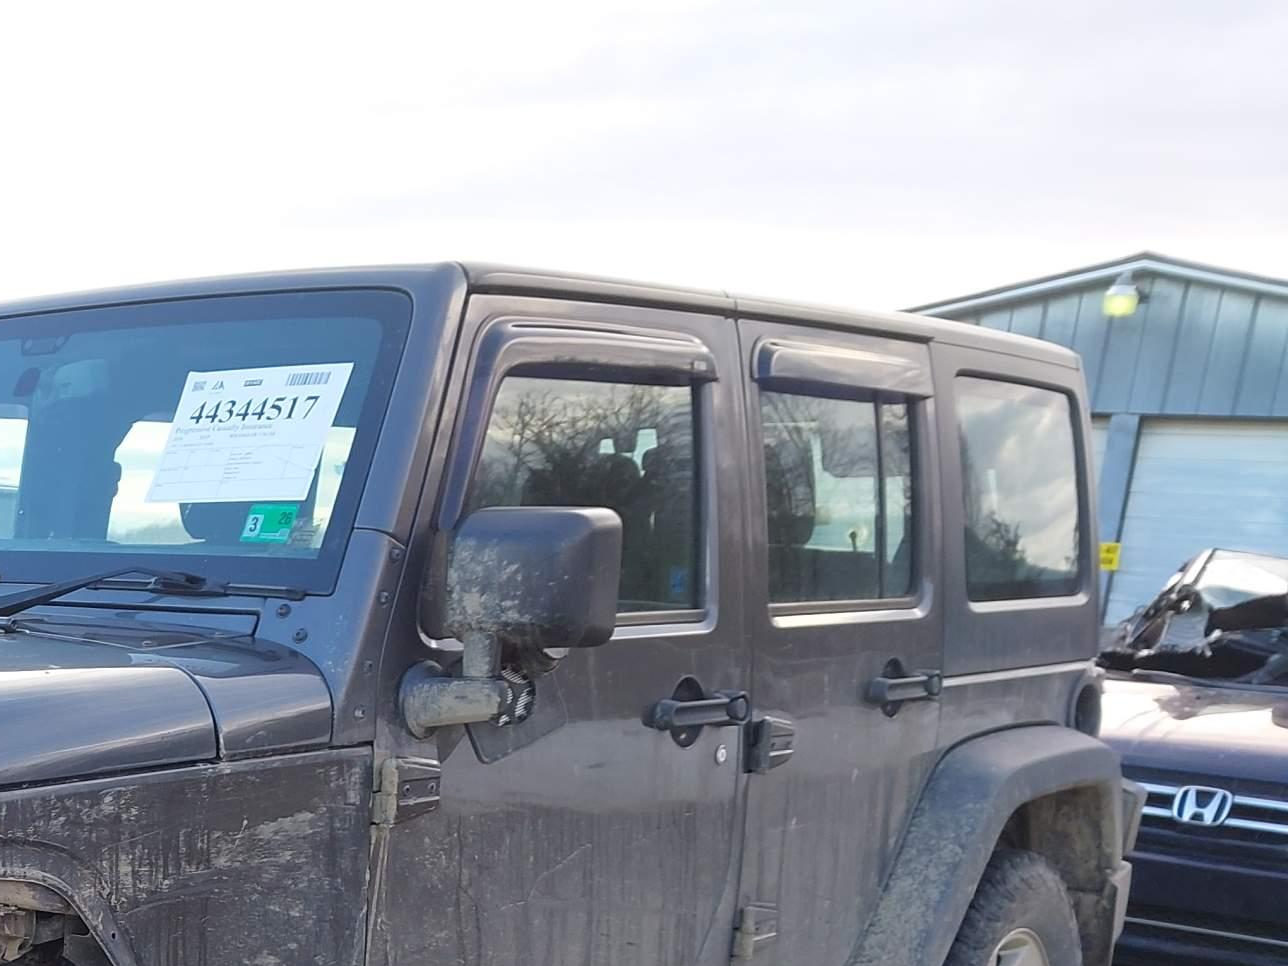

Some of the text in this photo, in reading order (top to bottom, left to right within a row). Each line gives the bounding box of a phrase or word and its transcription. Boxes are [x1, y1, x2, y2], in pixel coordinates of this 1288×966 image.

[190, 395, 321, 425] 44344517
[248, 511, 294, 532] 3 26
